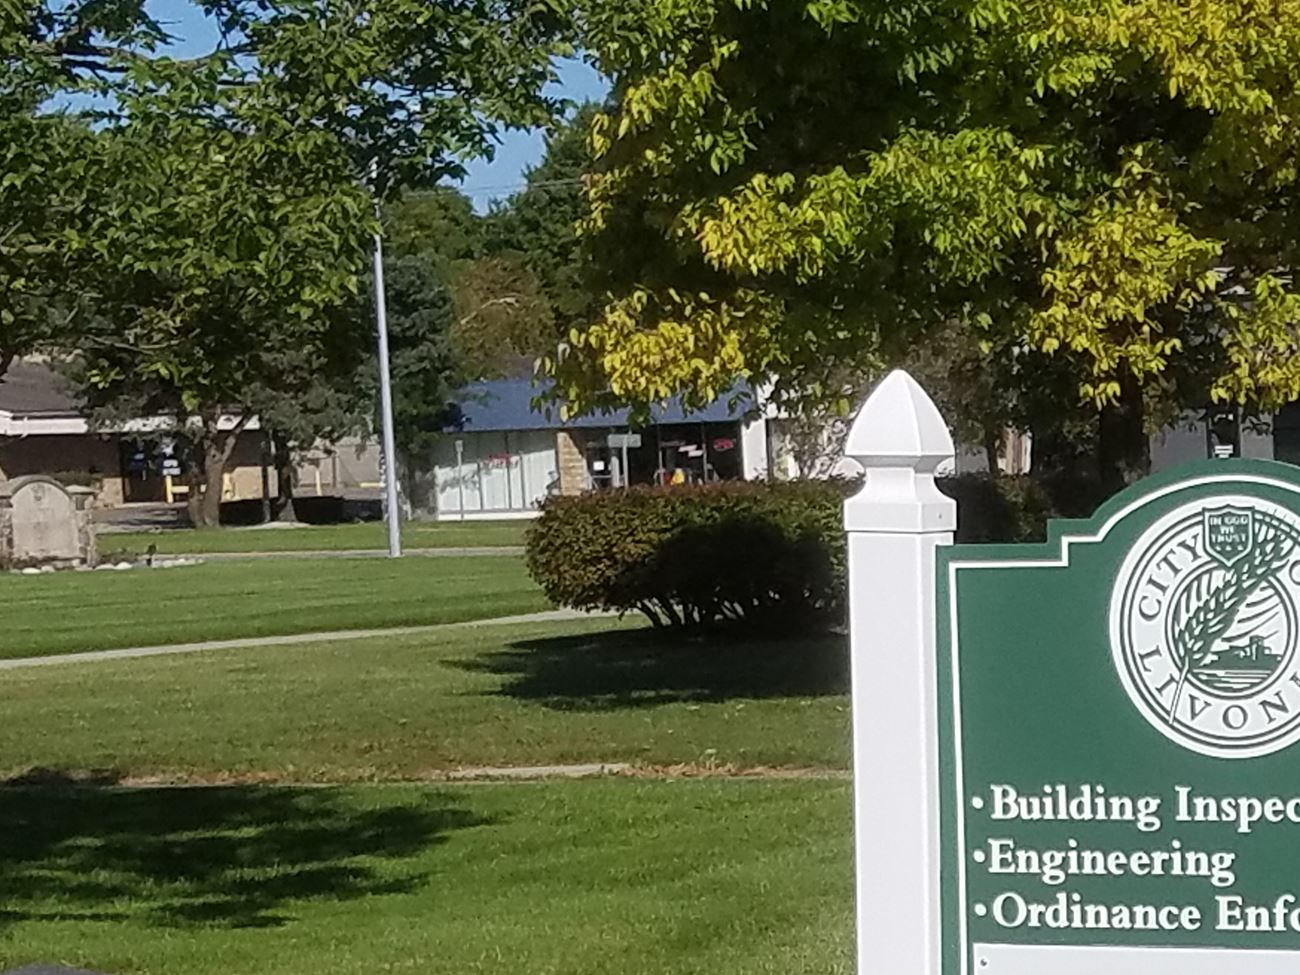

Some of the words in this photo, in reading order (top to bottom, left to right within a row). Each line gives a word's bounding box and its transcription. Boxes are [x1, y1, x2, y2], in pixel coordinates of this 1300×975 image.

[1138, 532, 1202, 622] CITY
[990, 784, 1161, 832] Building
[987, 837, 1236, 887] Engineering
[992, 892, 1201, 930] Ordinance
